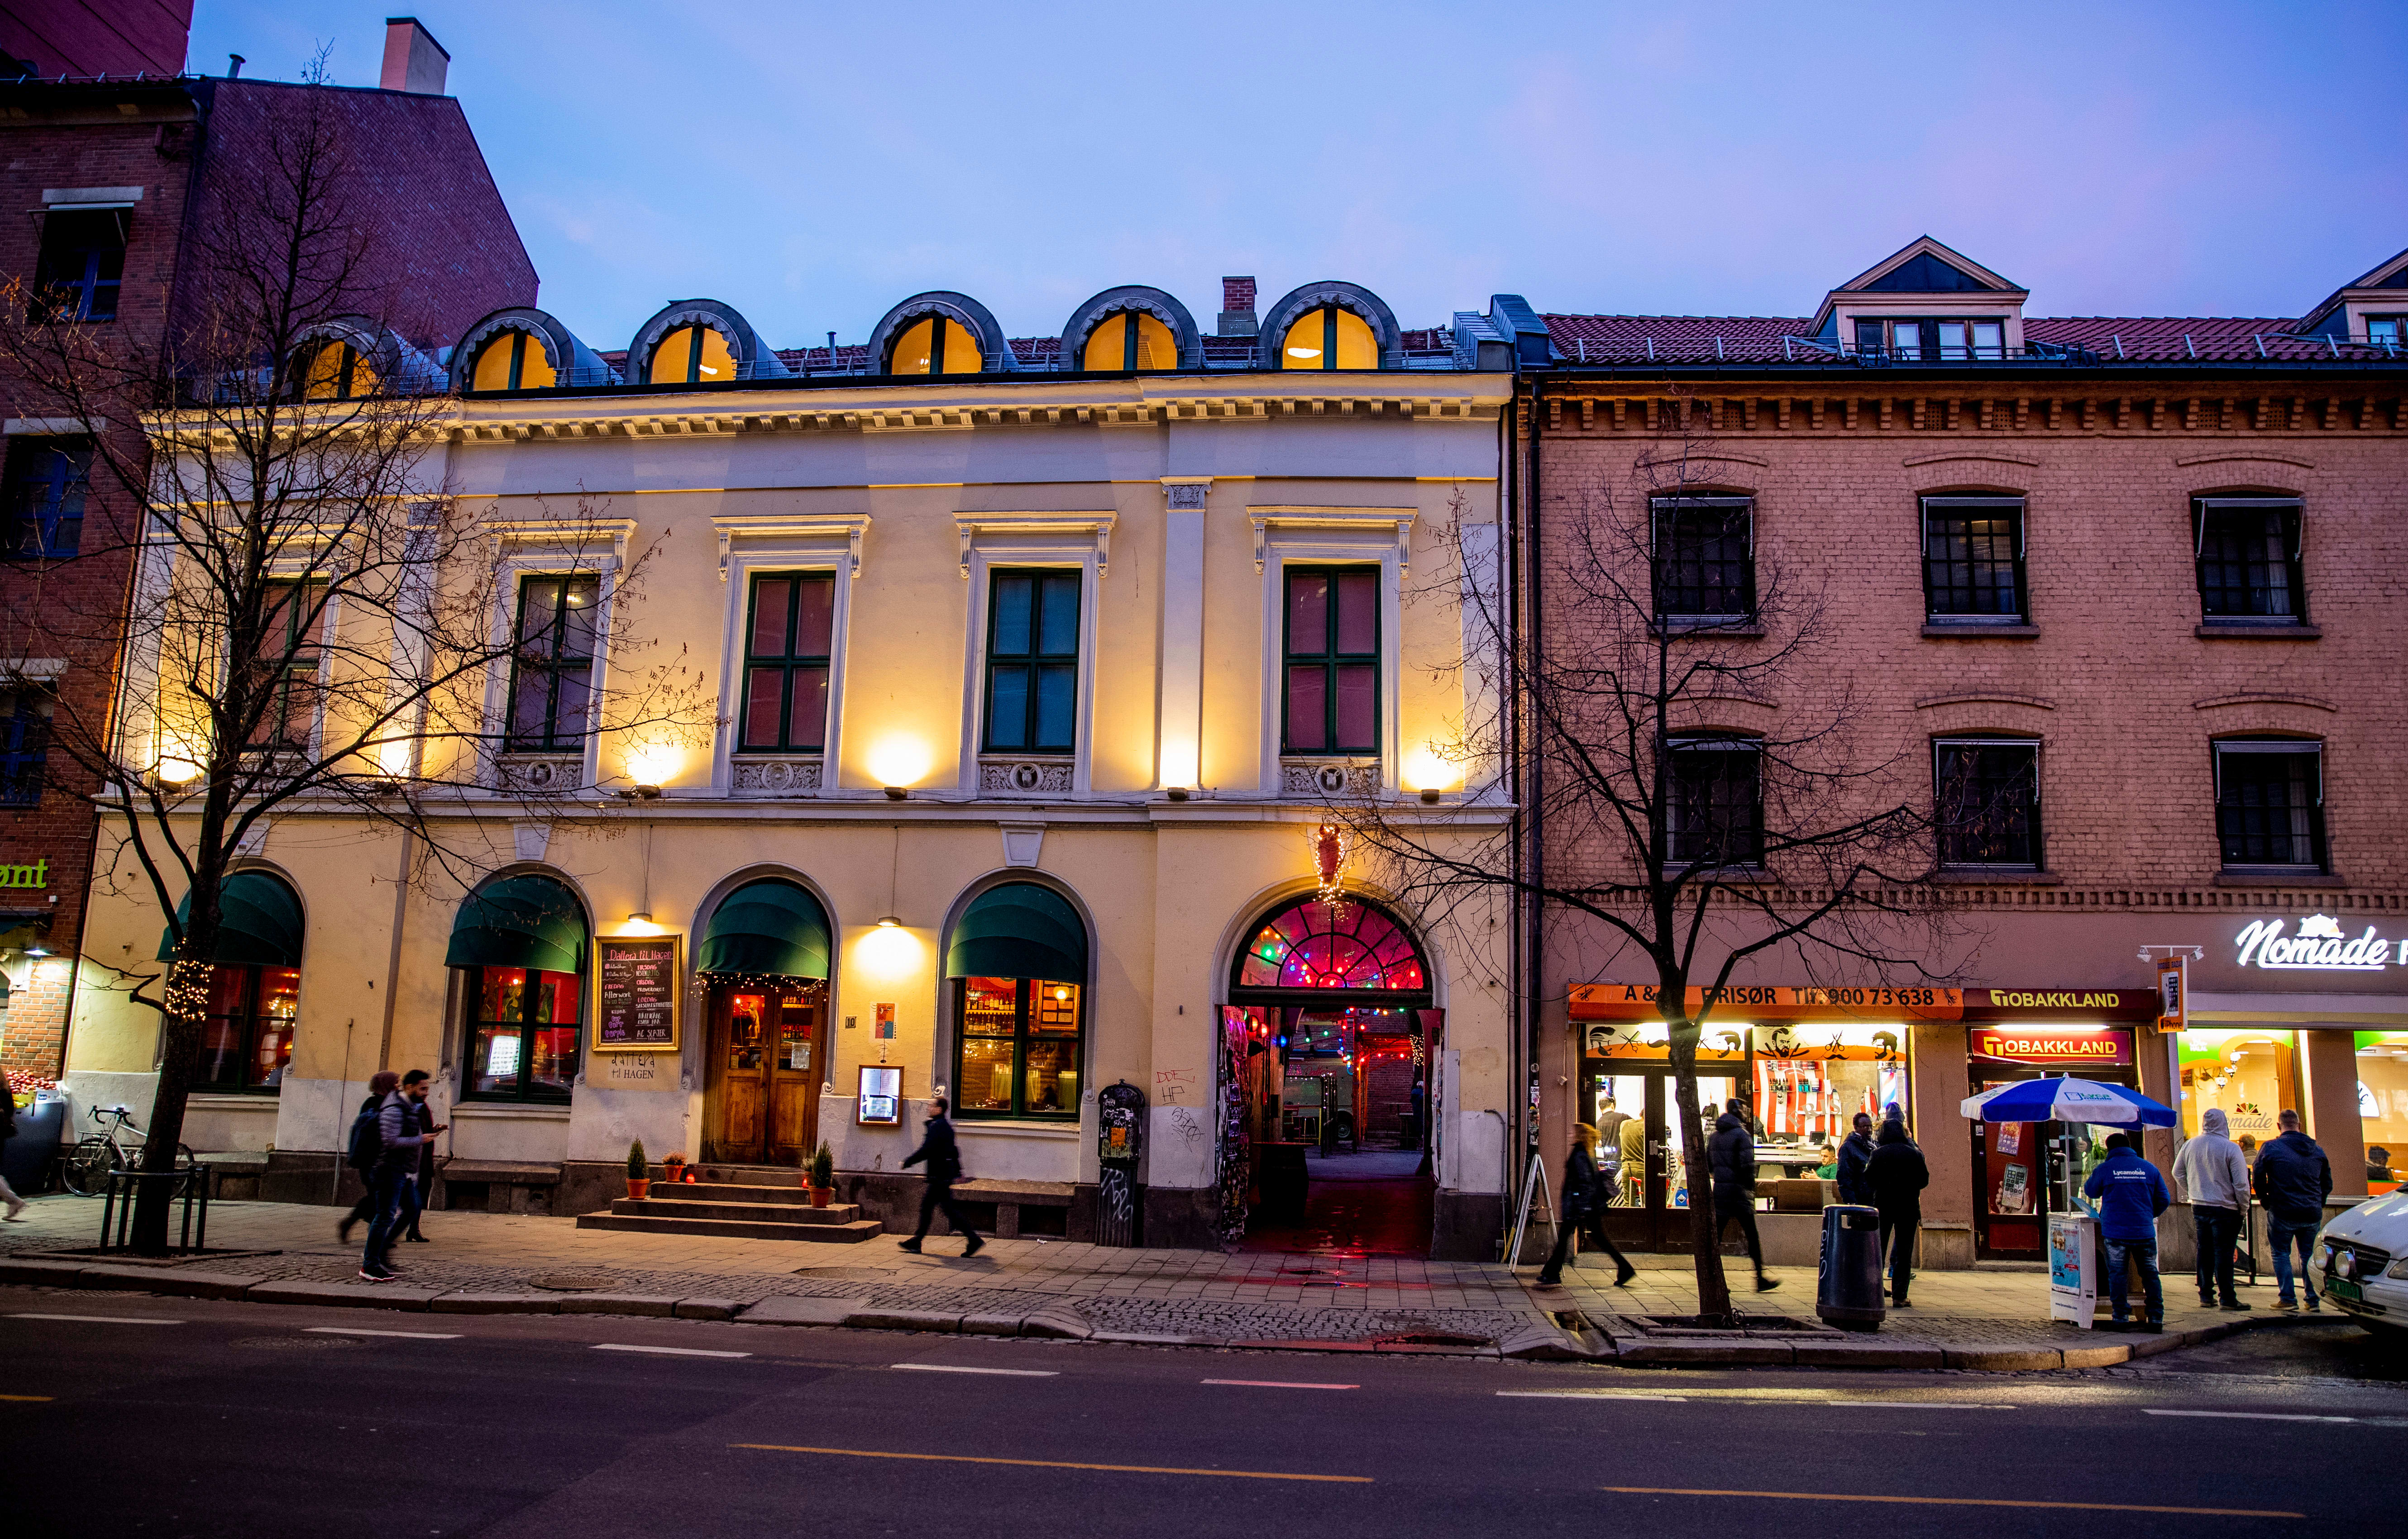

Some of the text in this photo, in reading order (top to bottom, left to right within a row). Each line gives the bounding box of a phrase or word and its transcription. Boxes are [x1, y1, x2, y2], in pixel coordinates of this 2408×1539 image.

[2235, 918, 2390, 969] Nomade
[610, 949, 672, 964] Dattera til Hagen
[1624, 985, 1638, 1001] A
[1828, 988, 1864, 1005] 900
[1868, 989, 1893, 1005] 73
[1899, 989, 1935, 1005] 638
[1990, 990, 2119, 1007] TOBAKKLAND
[847, 1017, 855, 1026] 10
[2165, 1020, 2182, 1029] iPhone
[647, 1029, 666, 1037] SLATER
[1983, 1037, 2117, 1056] TOBAKKLAND
[612, 1068, 654, 1079] til HAGEN
